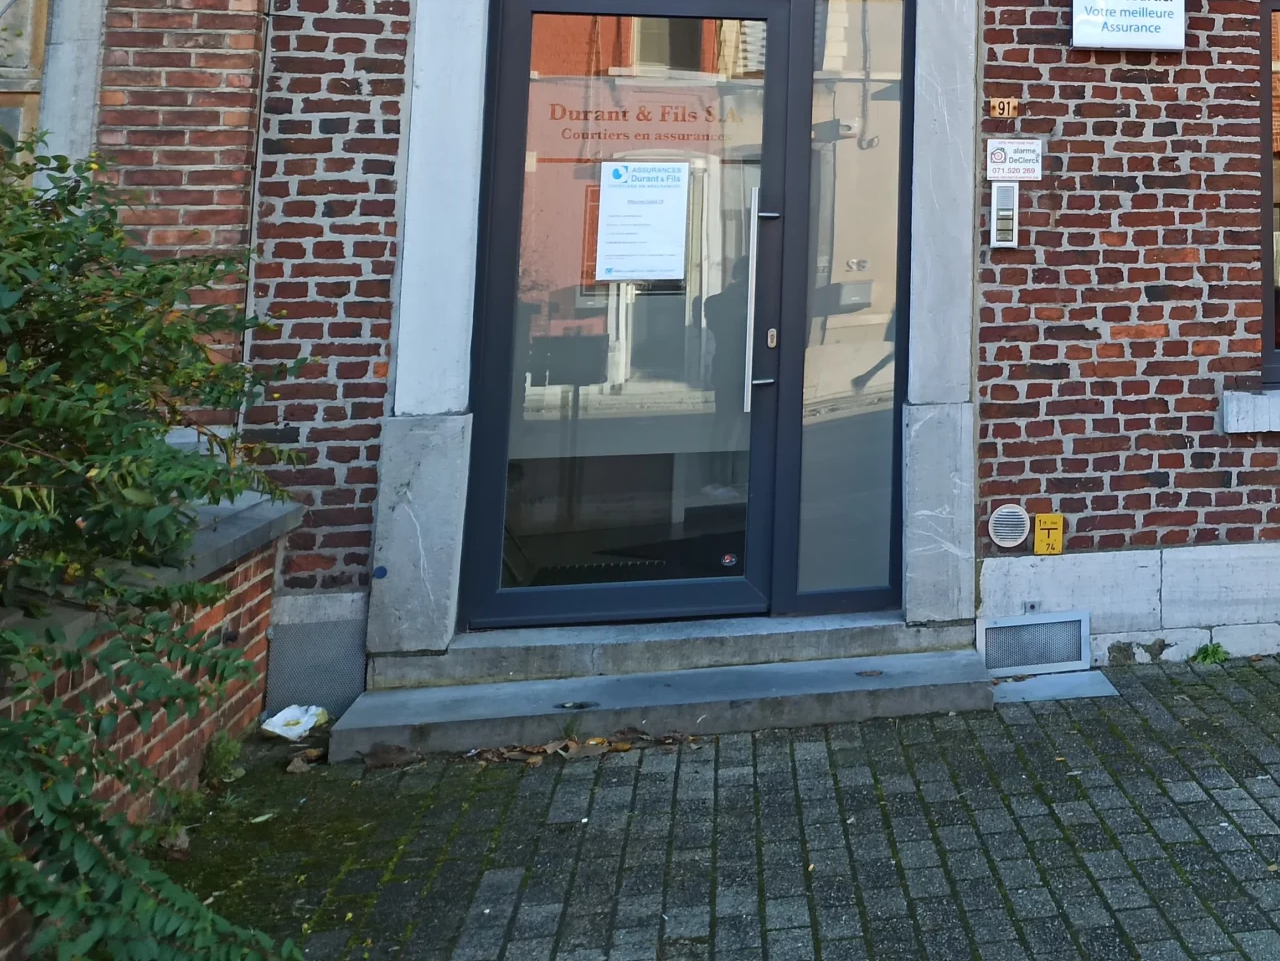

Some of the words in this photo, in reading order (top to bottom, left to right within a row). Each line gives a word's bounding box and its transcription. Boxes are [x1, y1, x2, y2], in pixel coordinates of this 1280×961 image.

[1084, 6, 1117, 17] Votre
[1119, 7, 1175, 19] meilleure
[1101, 21, 1161, 34] Assurance
[548, 103, 629, 122] Durant
[635, 105, 653, 122] &
[659, 105, 698, 123] Fils
[704, 106, 744, 124] S.A.
[998, 100, 1010, 116] 91
[561, 127, 630, 141] Courtiers
[634, 131, 650, 141] en
[1008, 156, 1040, 164] DeClerck
[631, 175, 659, 183] Durant
